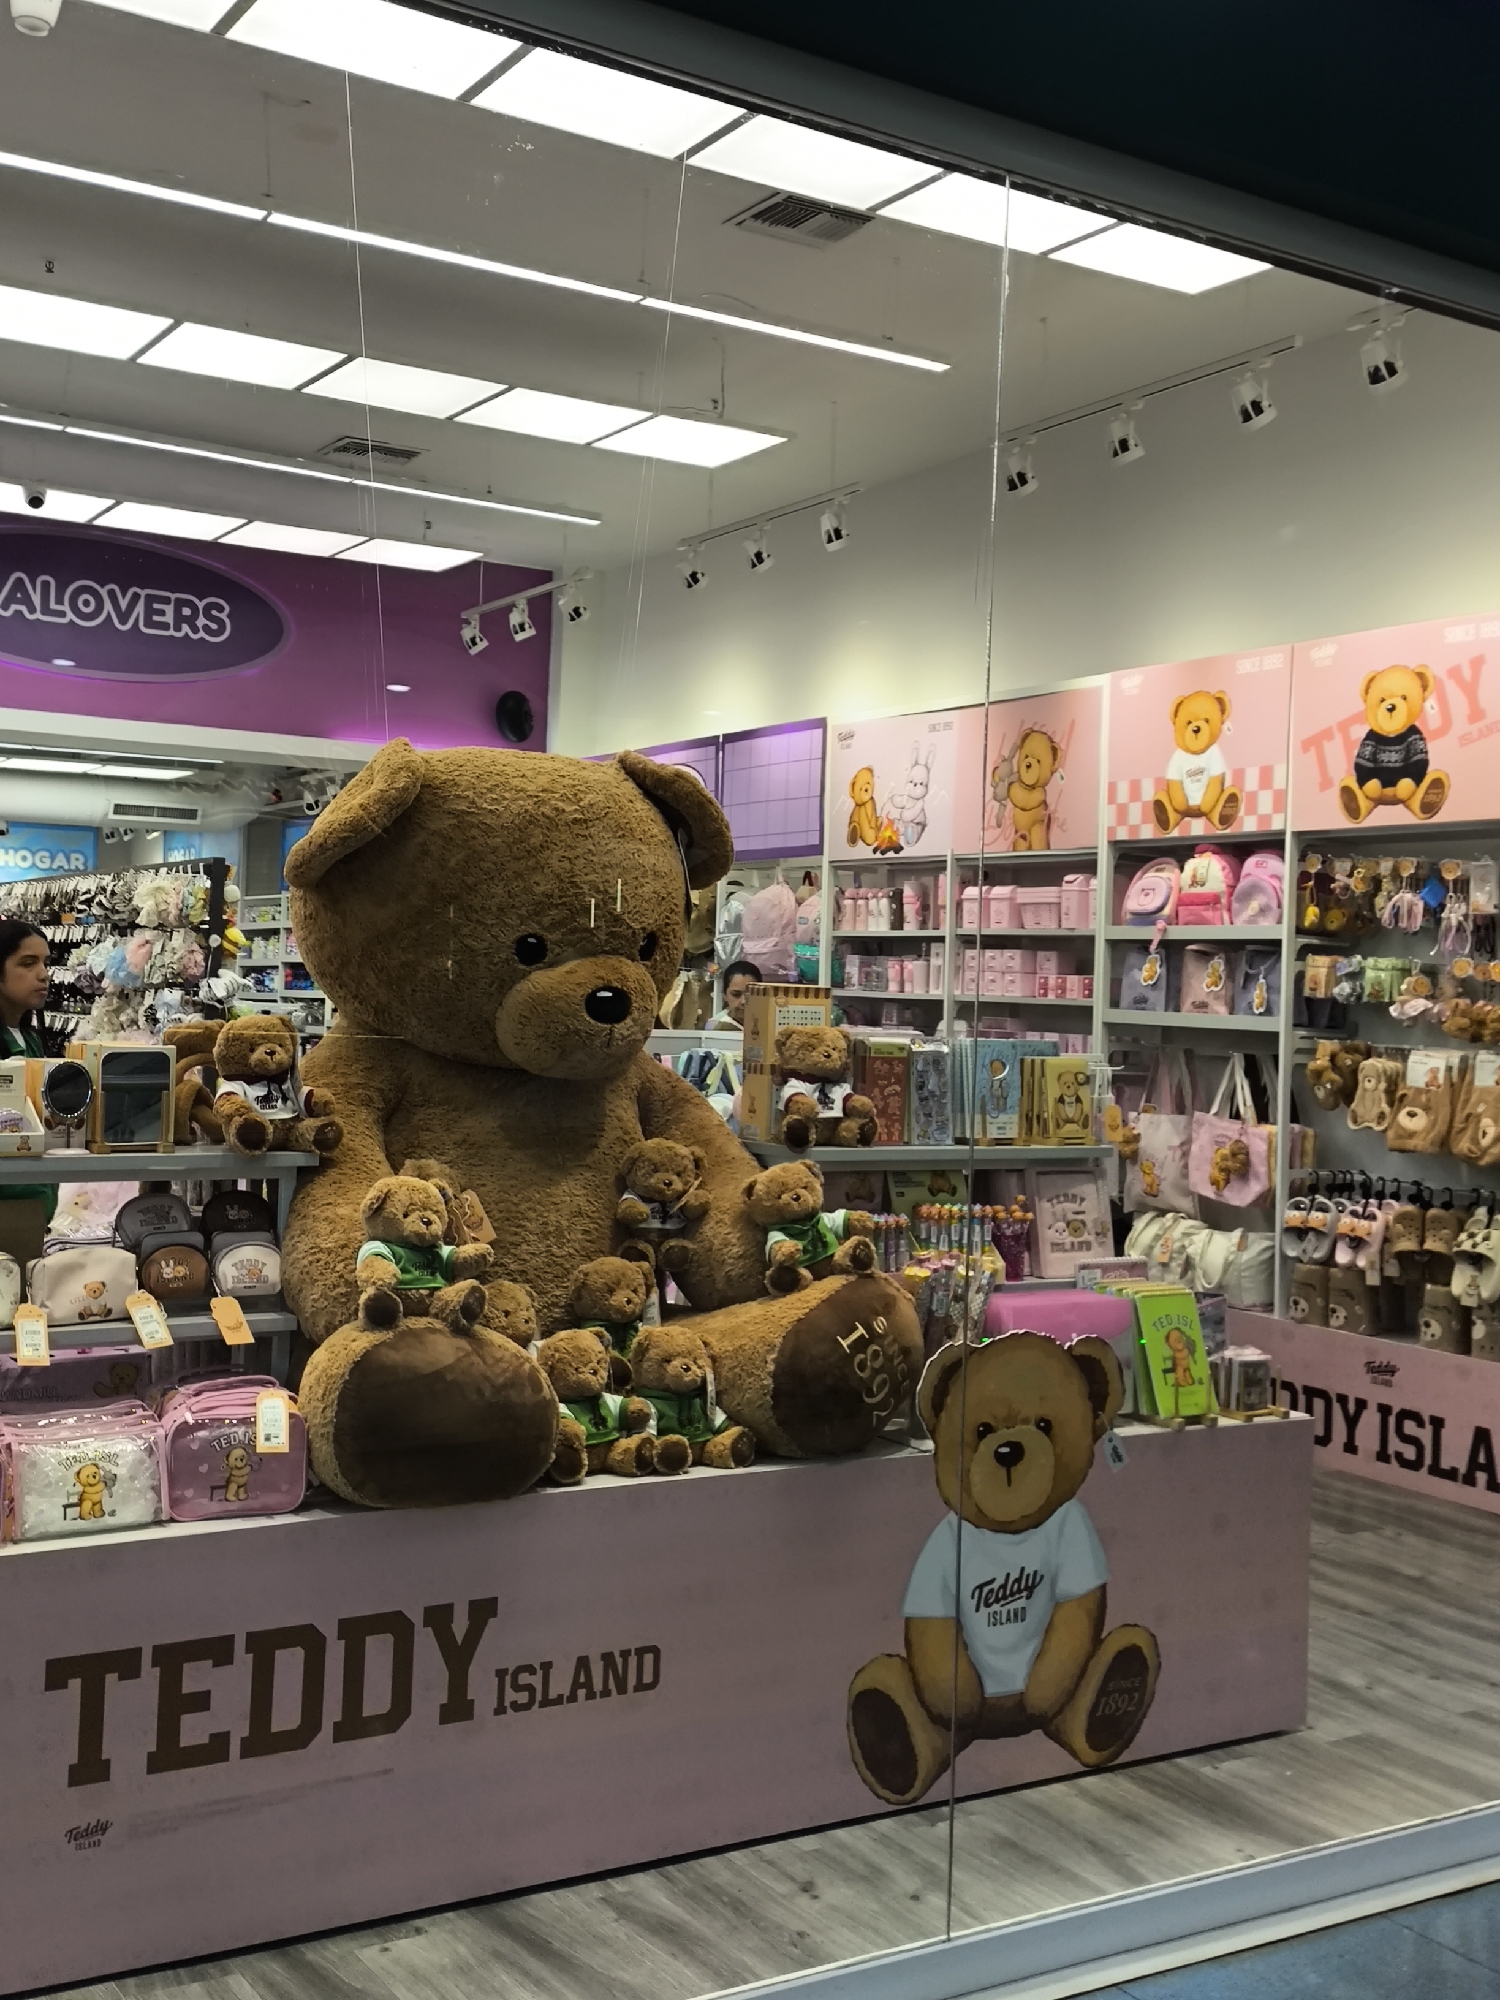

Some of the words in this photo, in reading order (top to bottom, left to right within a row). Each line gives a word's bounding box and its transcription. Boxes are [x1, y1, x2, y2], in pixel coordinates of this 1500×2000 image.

[0, 572, 231, 642] ALOVERS
[1479, 621, 1500, 639] 189
[0, 848, 86, 870] HOGAR
[210, 1431, 257, 1453] TED.IS
[971, 1566, 1045, 1613] Teddy
[987, 1607, 1027, 1628] ISLAND
[45, 1596, 499, 1788] TEDDY
[493, 1644, 662, 1717] ISLAND
[1096, 1692, 1139, 1717] 1892
[64, 1818, 113, 1844] Teddy
[75, 1838, 102, 1851] ISLAND
